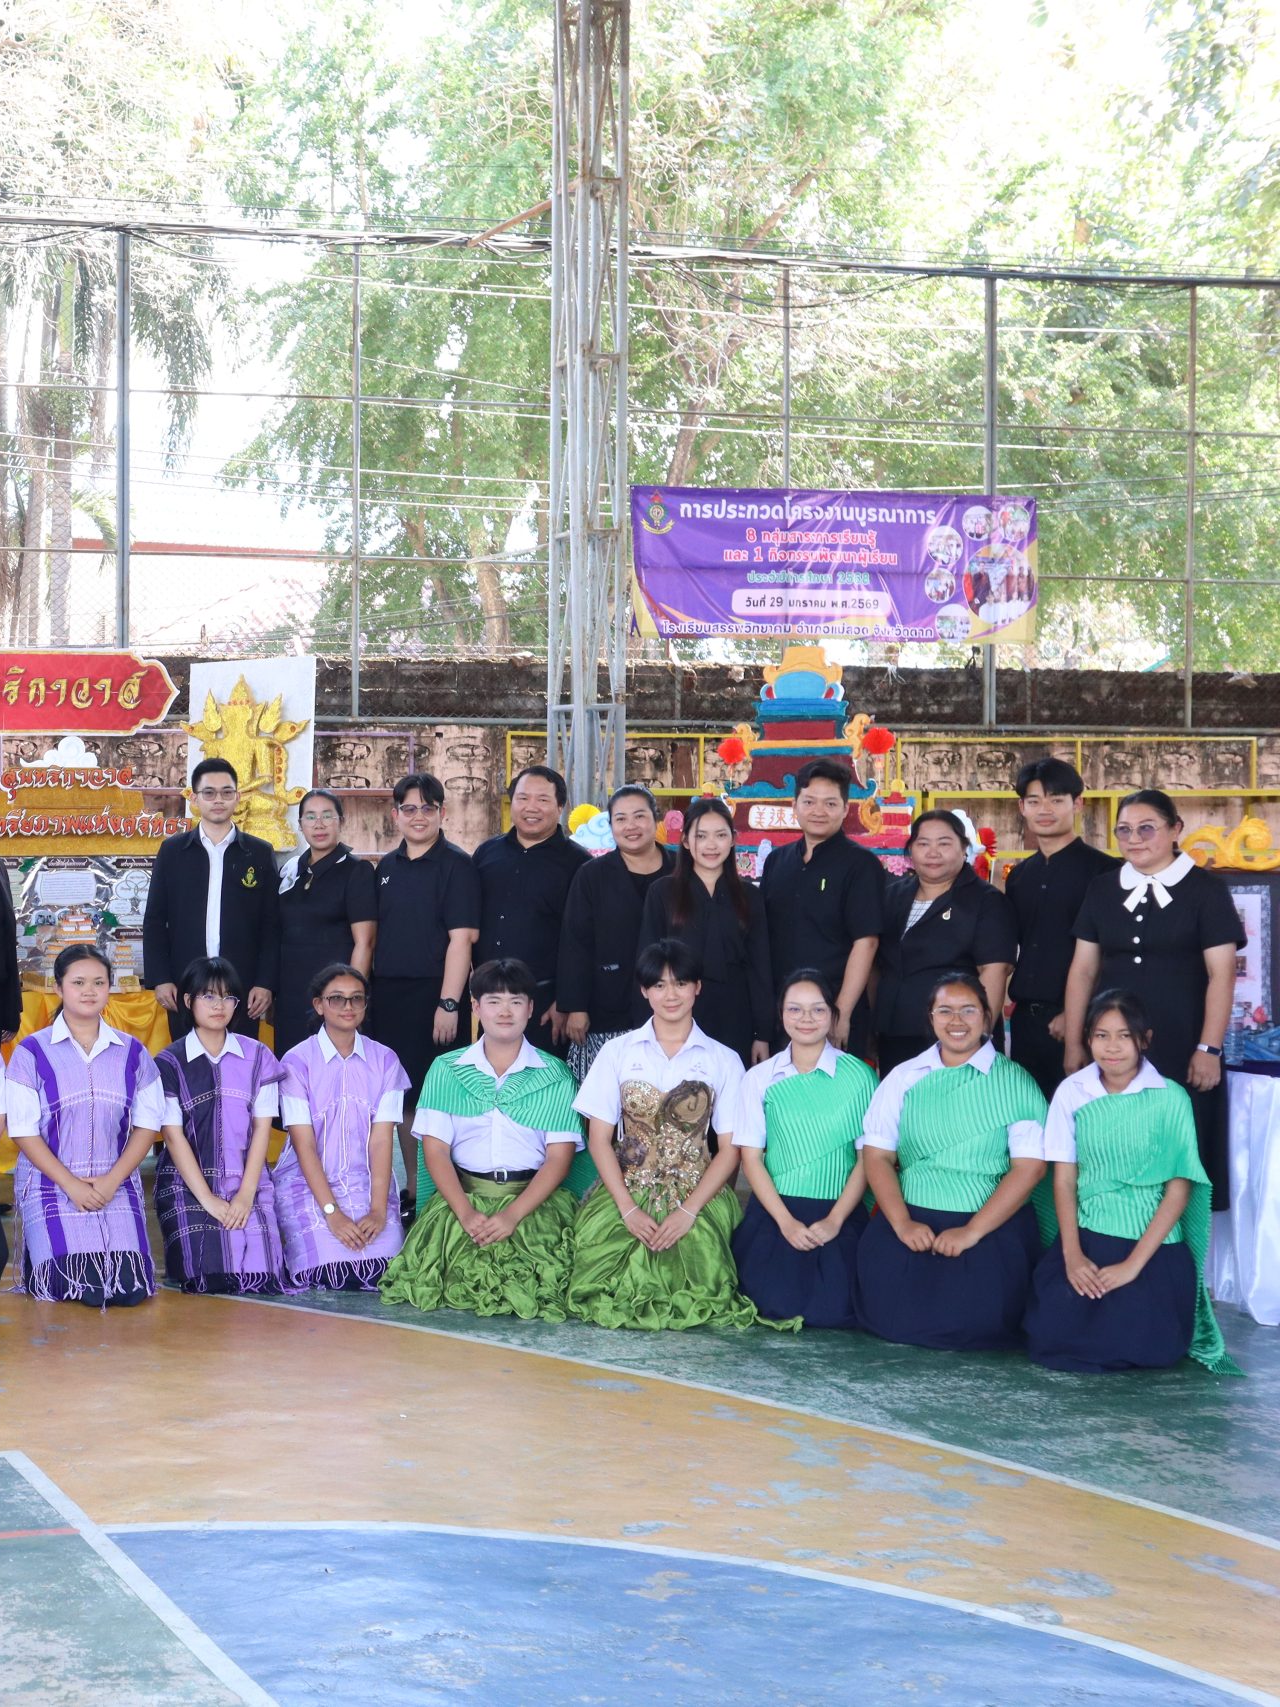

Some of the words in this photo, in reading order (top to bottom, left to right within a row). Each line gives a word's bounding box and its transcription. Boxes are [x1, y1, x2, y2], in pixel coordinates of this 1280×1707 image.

[679, 496, 937, 527] การประกวดโครงงานบูรณาการ
[746, 527, 757, 543] 8
[761, 527, 877, 549] กลุ่มสาระการเรียนรู้
[723, 549, 749, 562] และ
[753, 546, 763, 562] 1
[768, 547, 898, 567] กิจกรรมพัฒนาผู้เรียน
[837, 571, 870, 586] 2568
[745, 594, 767, 608] วันที่
[770, 596, 784, 608] 29
[788, 599, 827, 609] มกราคม
[662, 620, 792, 635] โรงเรียนสรรพวิทยาคม
